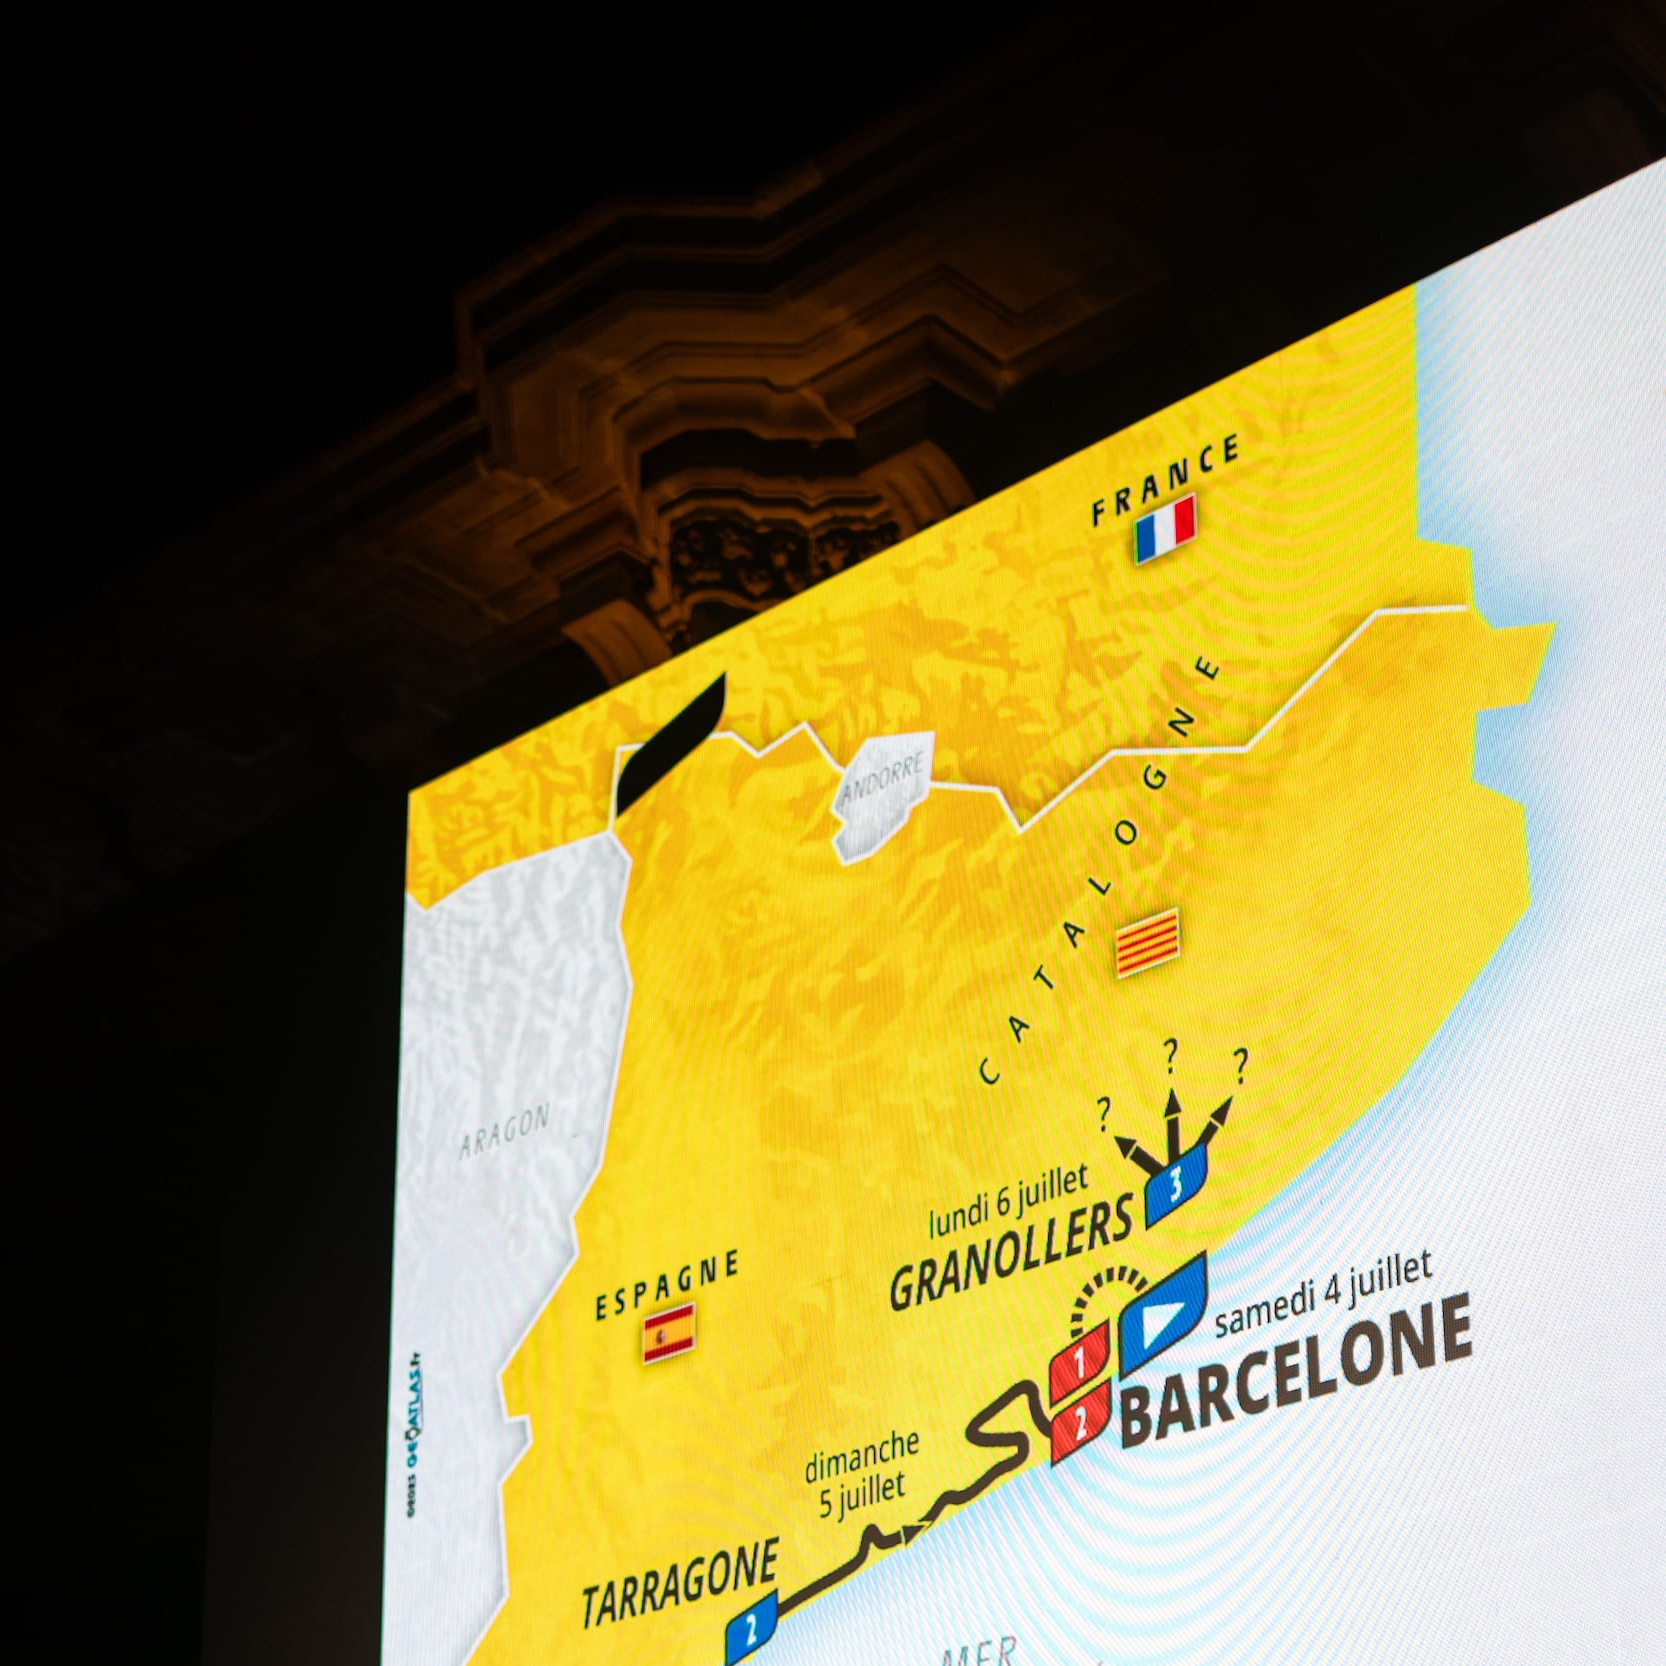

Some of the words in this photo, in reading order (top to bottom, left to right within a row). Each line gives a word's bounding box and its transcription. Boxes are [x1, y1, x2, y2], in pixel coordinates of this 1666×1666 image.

[1091, 434, 1239, 527] FRANCE
[840, 751, 923, 808] ANDORRE
[979, 655, 1219, 1085] CATALOGNE
[460, 1103, 550, 1161] ARAGON
[929, 1193, 990, 1239] lundi
[997, 1187, 1010, 1216] 6
[1017, 1164, 1088, 1219] juillet
[1169, 1166, 1183, 1201] 3
[596, 1249, 738, 1321] ESPAGNE
[890, 1193, 1133, 1312] GRANOLLERS
[1215, 1282, 1315, 1339] samedi
[1324, 1273, 1342, 1305] 4
[1349, 1249, 1433, 1298] juillet
[1073, 1346, 1085, 1378] 1
[1121, 1292, 1472, 1449] BARCELONE
[1074, 1405, 1087, 1440] 2
[805, 1430, 919, 1485] dimanche
[819, 1489, 832, 1519] 5
[837, 1472, 905, 1521] juillet
[582, 1537, 779, 1630] TARRAGONE
[745, 1614, 757, 1645] 2
